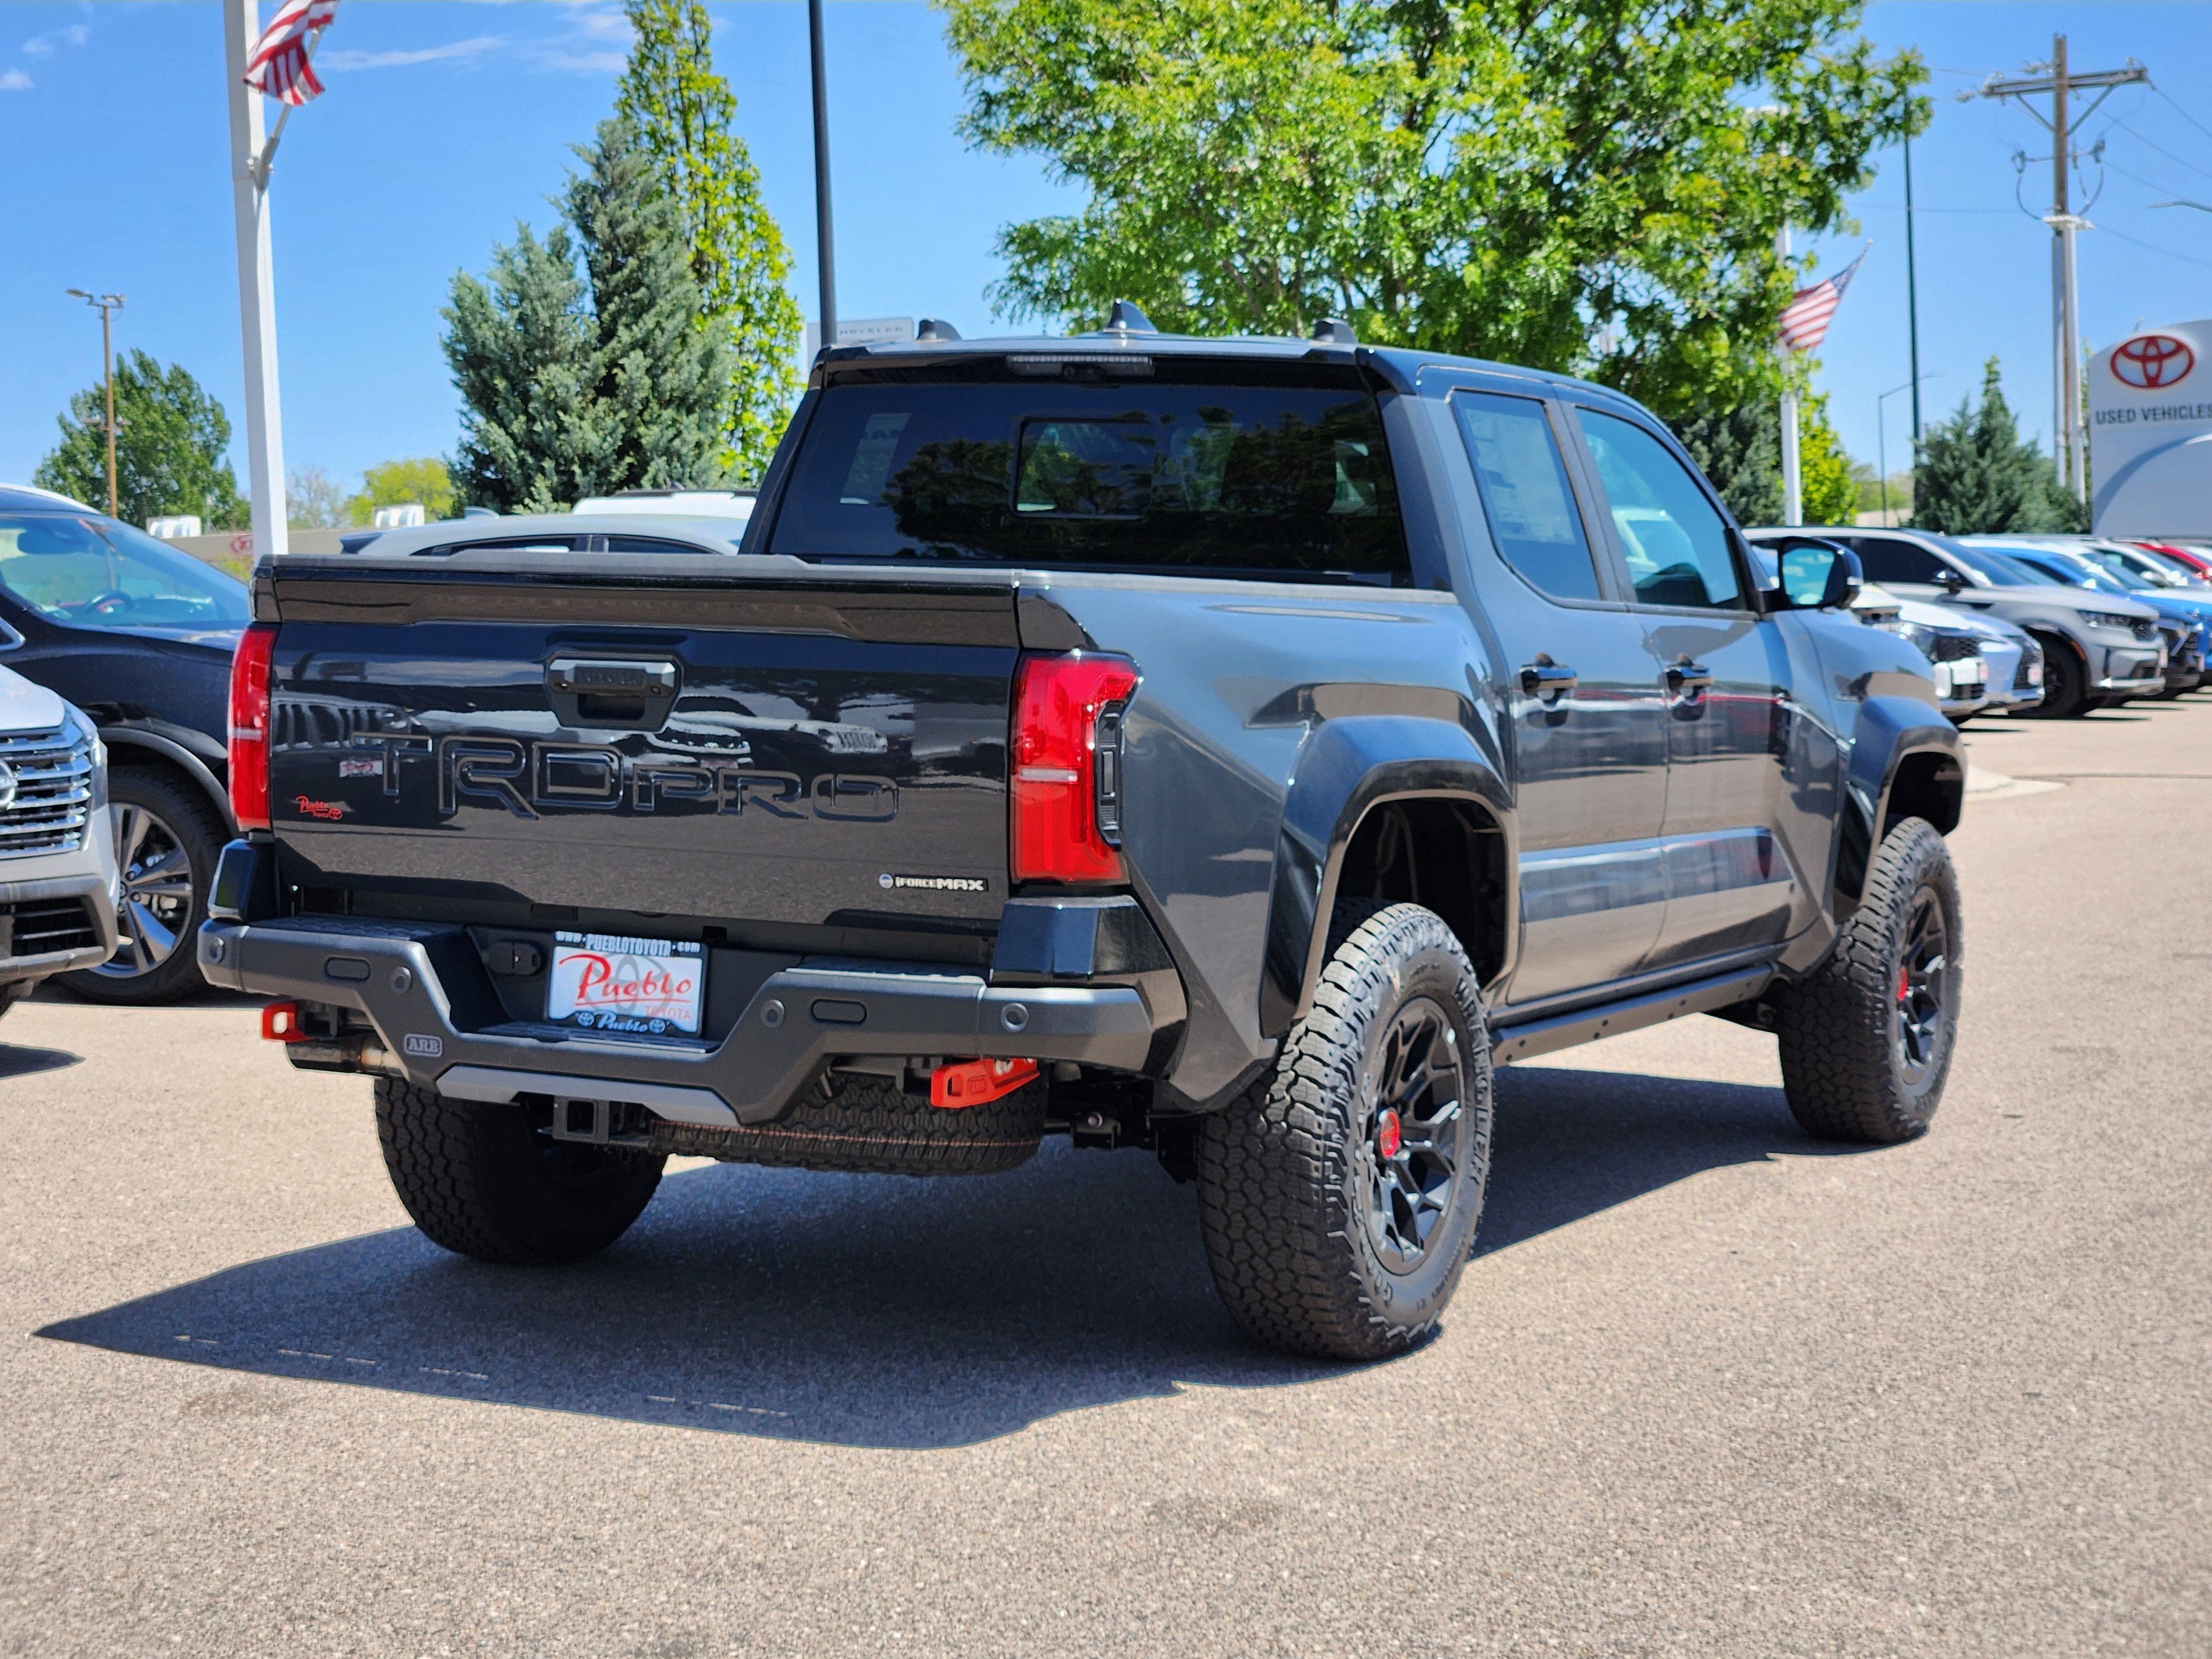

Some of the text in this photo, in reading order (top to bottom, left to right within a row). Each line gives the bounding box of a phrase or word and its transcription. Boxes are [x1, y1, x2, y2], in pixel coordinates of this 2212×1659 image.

[2095, 409, 2136, 425] USED
[351, 732, 899, 822] TRD PRO
[559, 953, 691, 1000] Pueblo
[593, 1010, 649, 1032] Pueblo
[408, 1036, 439, 1052] ARB
